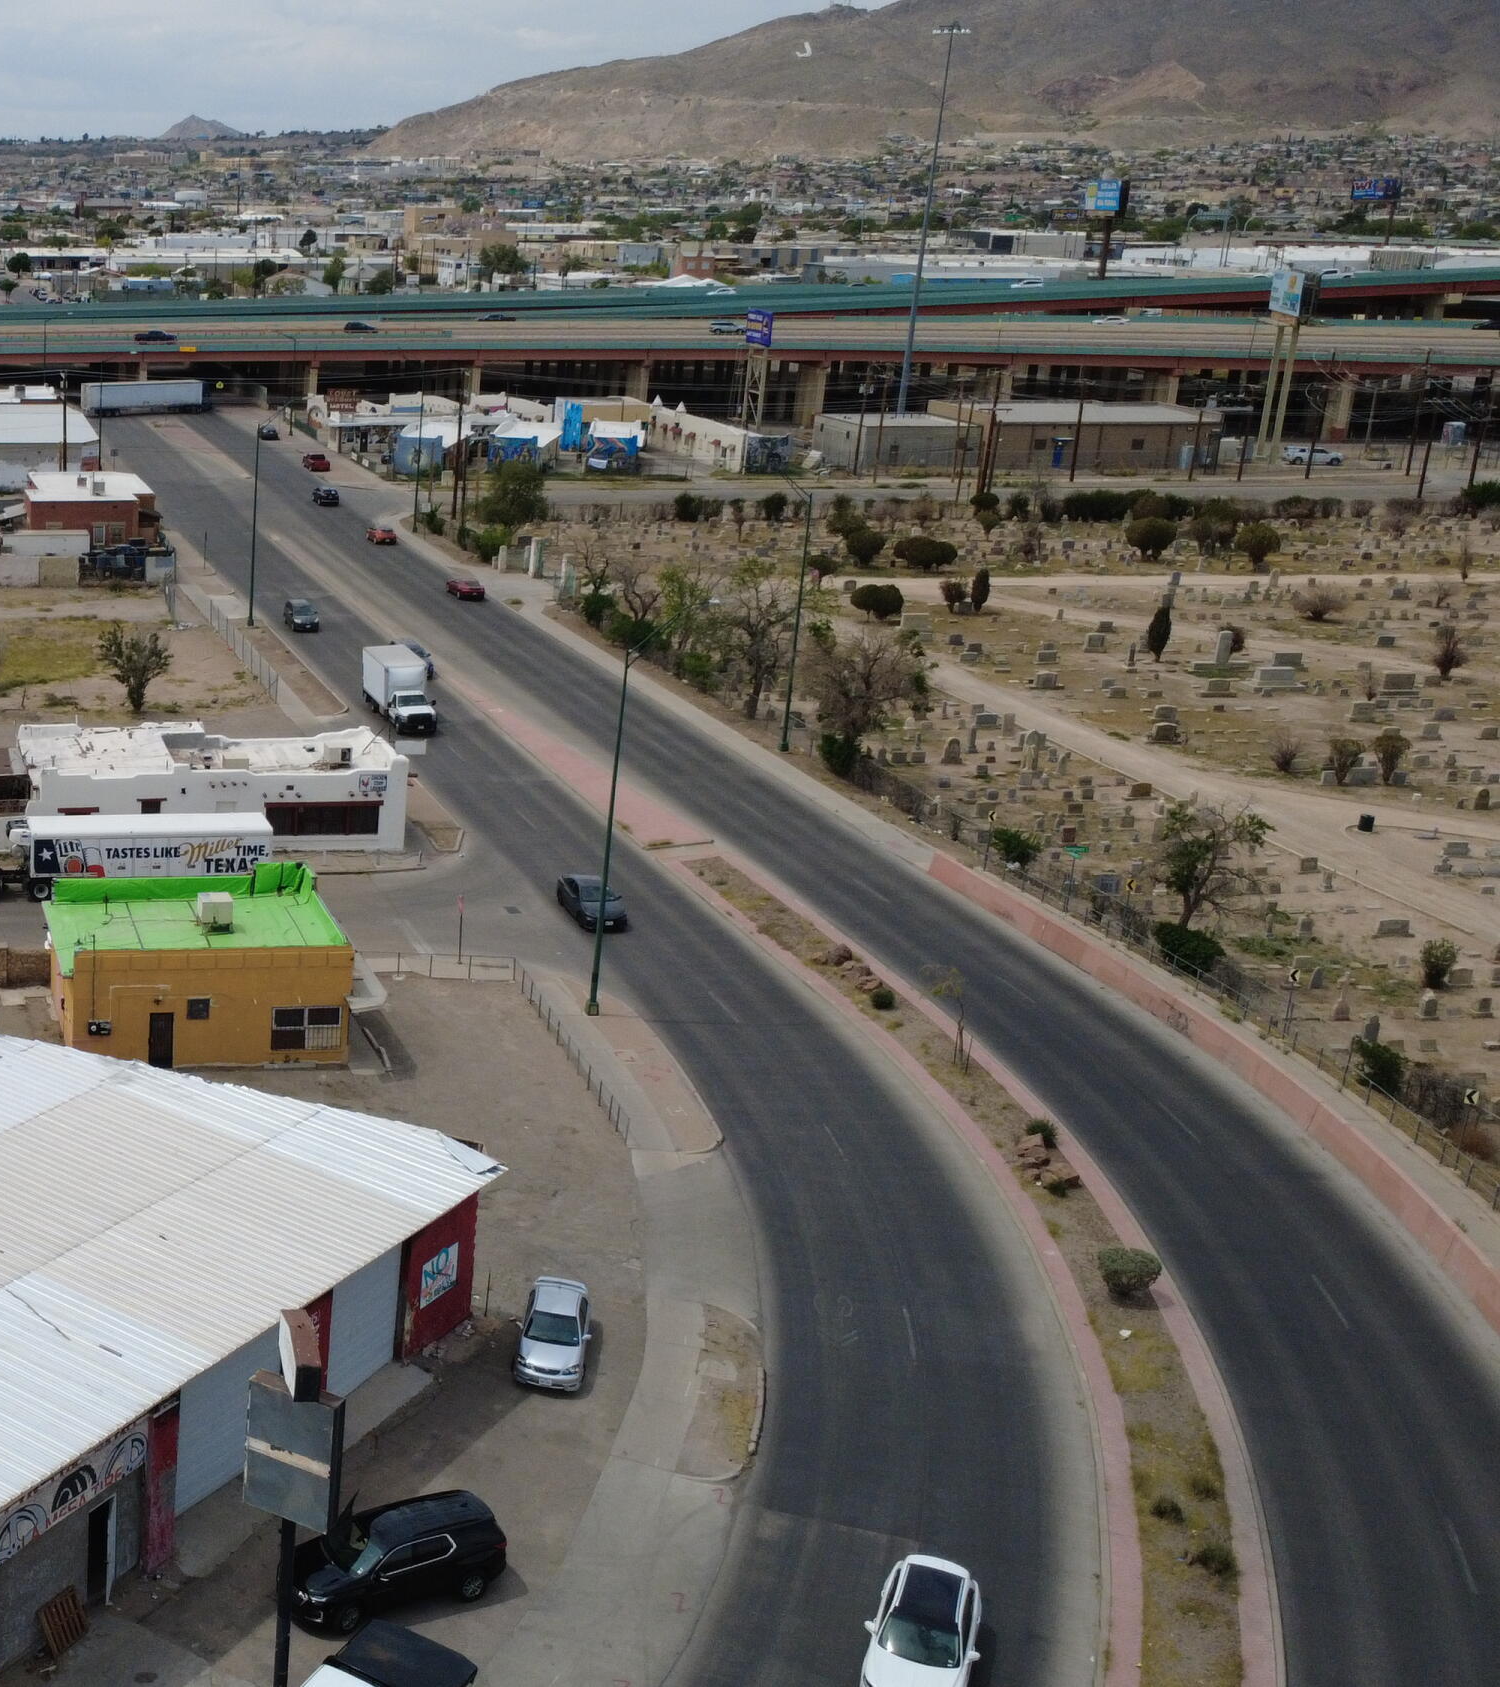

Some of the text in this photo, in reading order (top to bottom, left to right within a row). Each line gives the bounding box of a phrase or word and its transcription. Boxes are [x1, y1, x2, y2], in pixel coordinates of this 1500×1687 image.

[105, 837, 269, 868] TASTES LIKE Miller TIME,
